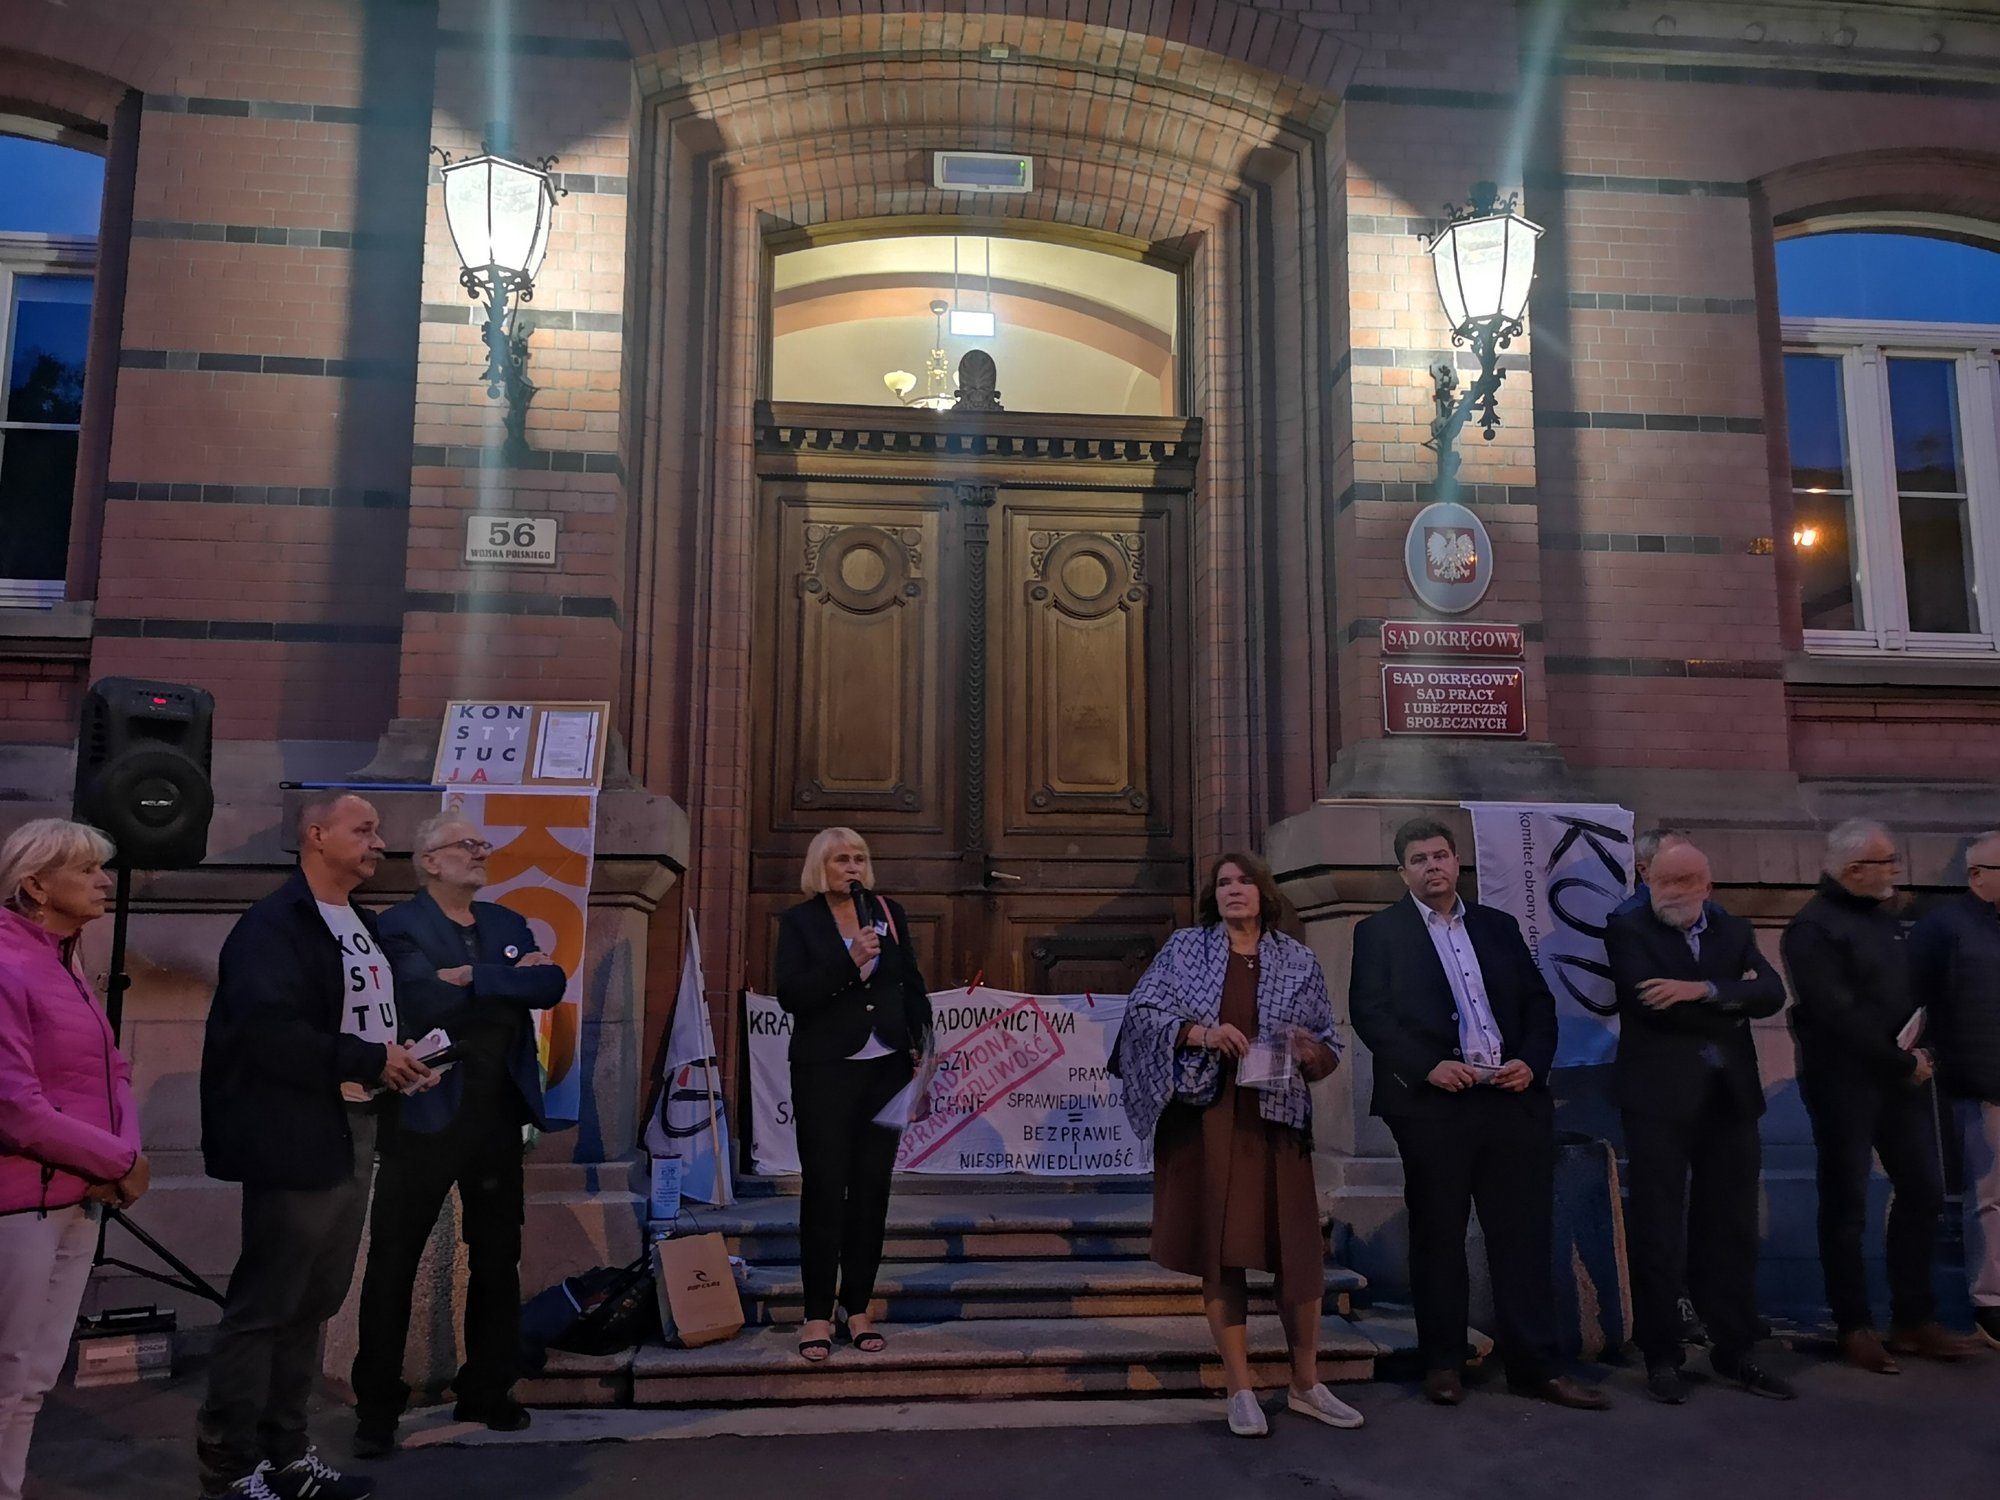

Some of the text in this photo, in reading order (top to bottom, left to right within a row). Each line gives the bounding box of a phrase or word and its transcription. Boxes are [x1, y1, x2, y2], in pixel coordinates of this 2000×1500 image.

[488, 521, 536, 547] 56
[471, 548, 550, 560] WOJSKA POLSKIEGO
[1388, 630, 1521, 649] SĄD OKRĘGOWY
[1393, 672, 1515, 688] SĄD OKRĘGOWY
[1416, 688, 1495, 703] SĄD PRACY
[459, 705, 525, 719] KON
[1404, 701, 1508, 715] I UBEZPIECZEŃ
[1406, 716, 1507, 730] SPOŁECZNYCH
[456, 726, 520, 740] STY
[454, 747, 516, 761] TUC
[448, 767, 488, 783] JA
[1524, 869, 1537, 925] obrony
[1528, 926, 1544, 970] demo
[350, 965, 390, 992] ST
[749, 1007, 1076, 1035] KRA ĄDOWNICTWA
[1069, 1067, 1111, 1082] PRAW
[1023, 1124, 1122, 1142] BEZPRAWIE
[959, 1147, 1134, 1170] NIESPRAWIEDLIWOŚĆ
